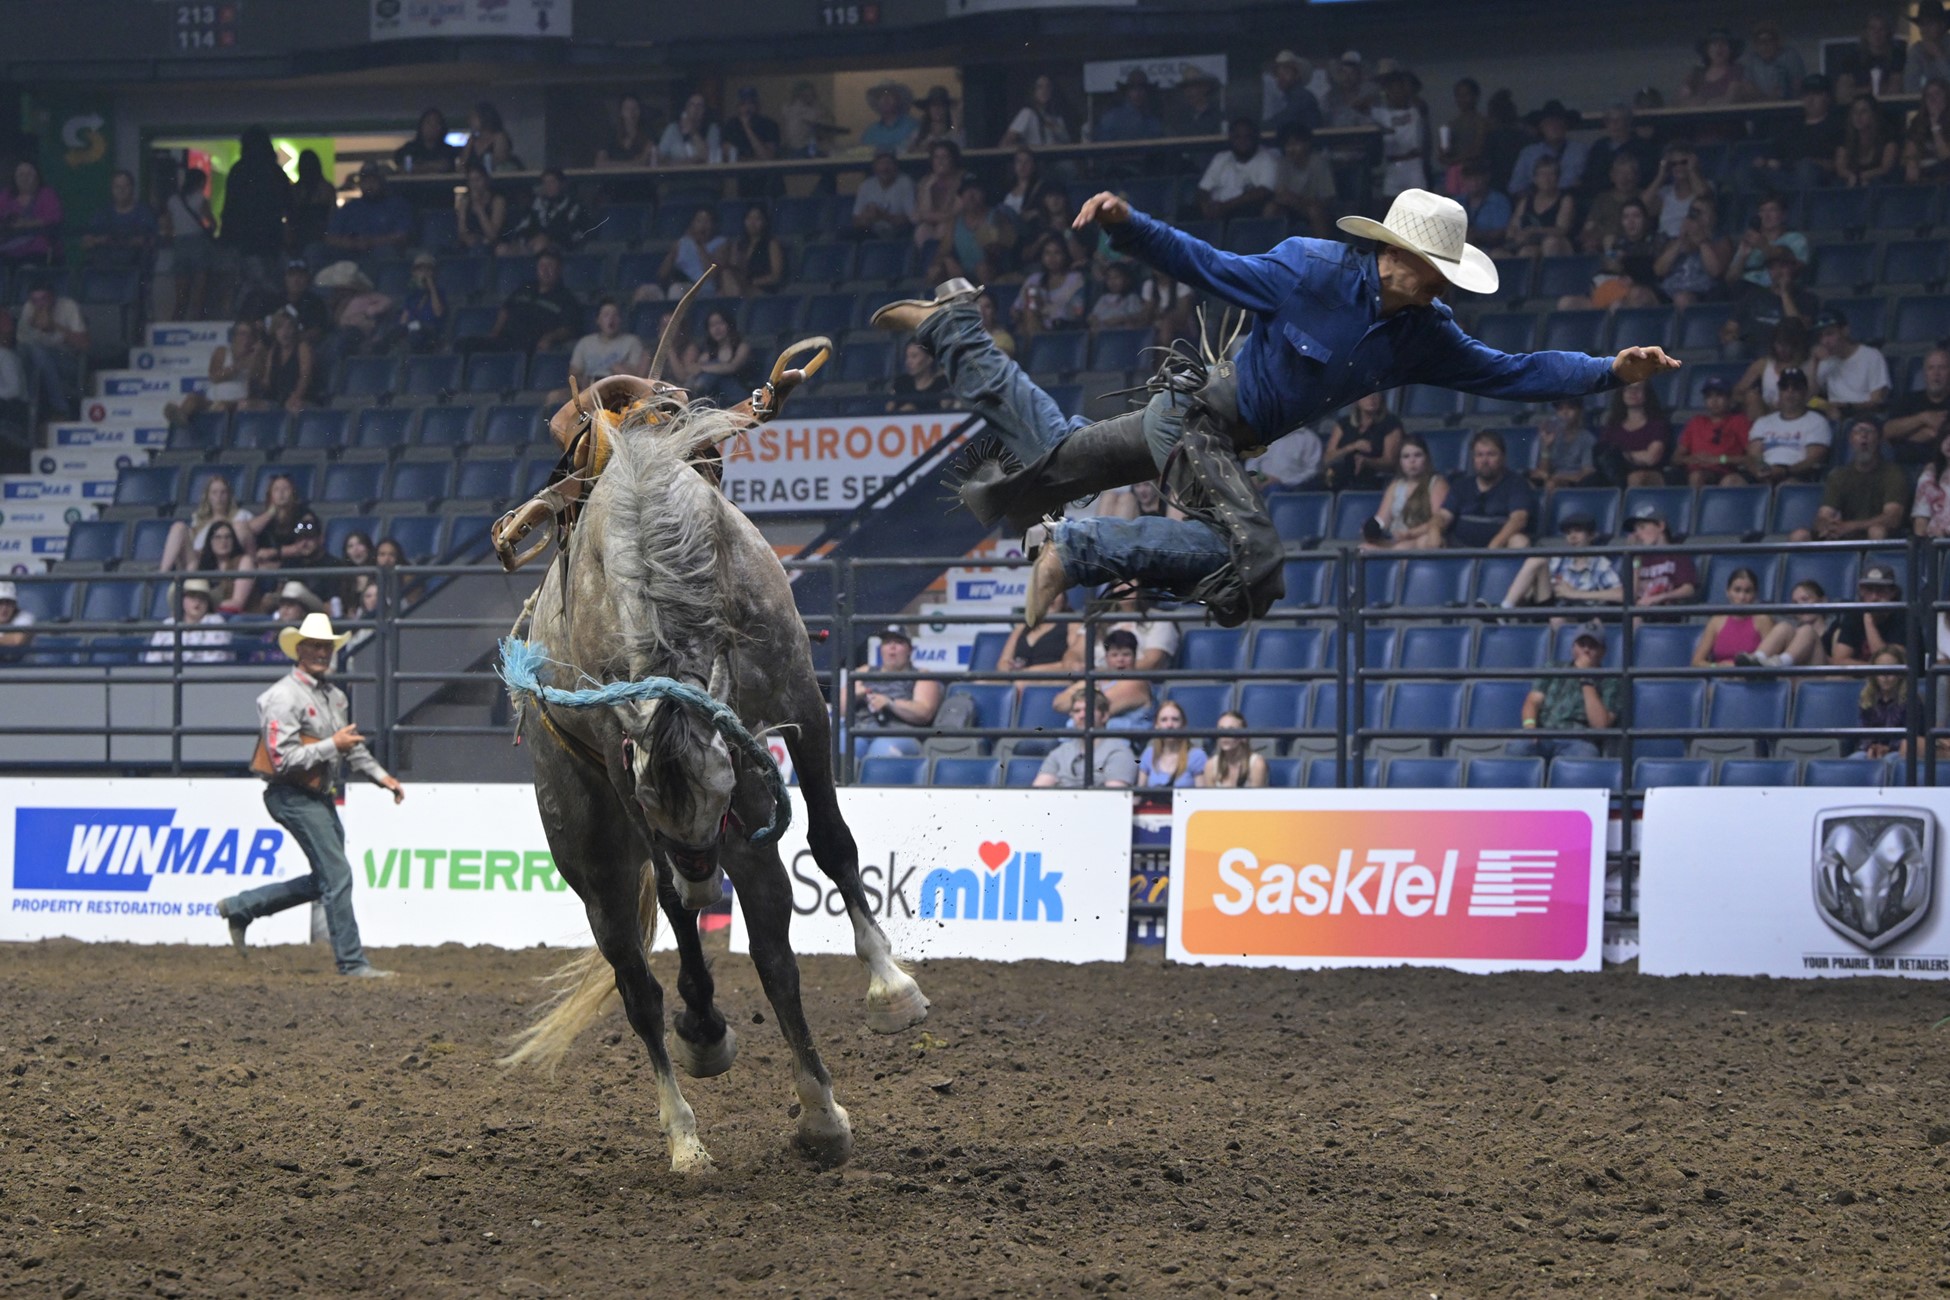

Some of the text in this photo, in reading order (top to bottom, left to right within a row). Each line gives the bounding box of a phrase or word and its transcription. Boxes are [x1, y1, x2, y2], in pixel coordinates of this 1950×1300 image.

[178, 6, 215, 25] 213
[824, 7, 859, 25] 115
[179, 31, 215, 49] 114
[117, 381, 171, 392] WINMAR
[69, 431, 124, 443] WINMAR
[716, 424, 968, 463] ASHROOMS
[16, 484, 72, 496] WINMAR
[968, 583, 1026, 598] WINMAR
[66, 824, 284, 876] WINMAR
[1212, 847, 1459, 918] SaskTel
[12, 898, 82, 914] PROPERTY
[87, 900, 182, 917] RESTORATION
[1802, 957, 1949, 972] YOUR PRAIRIE RAM RETAILERS
